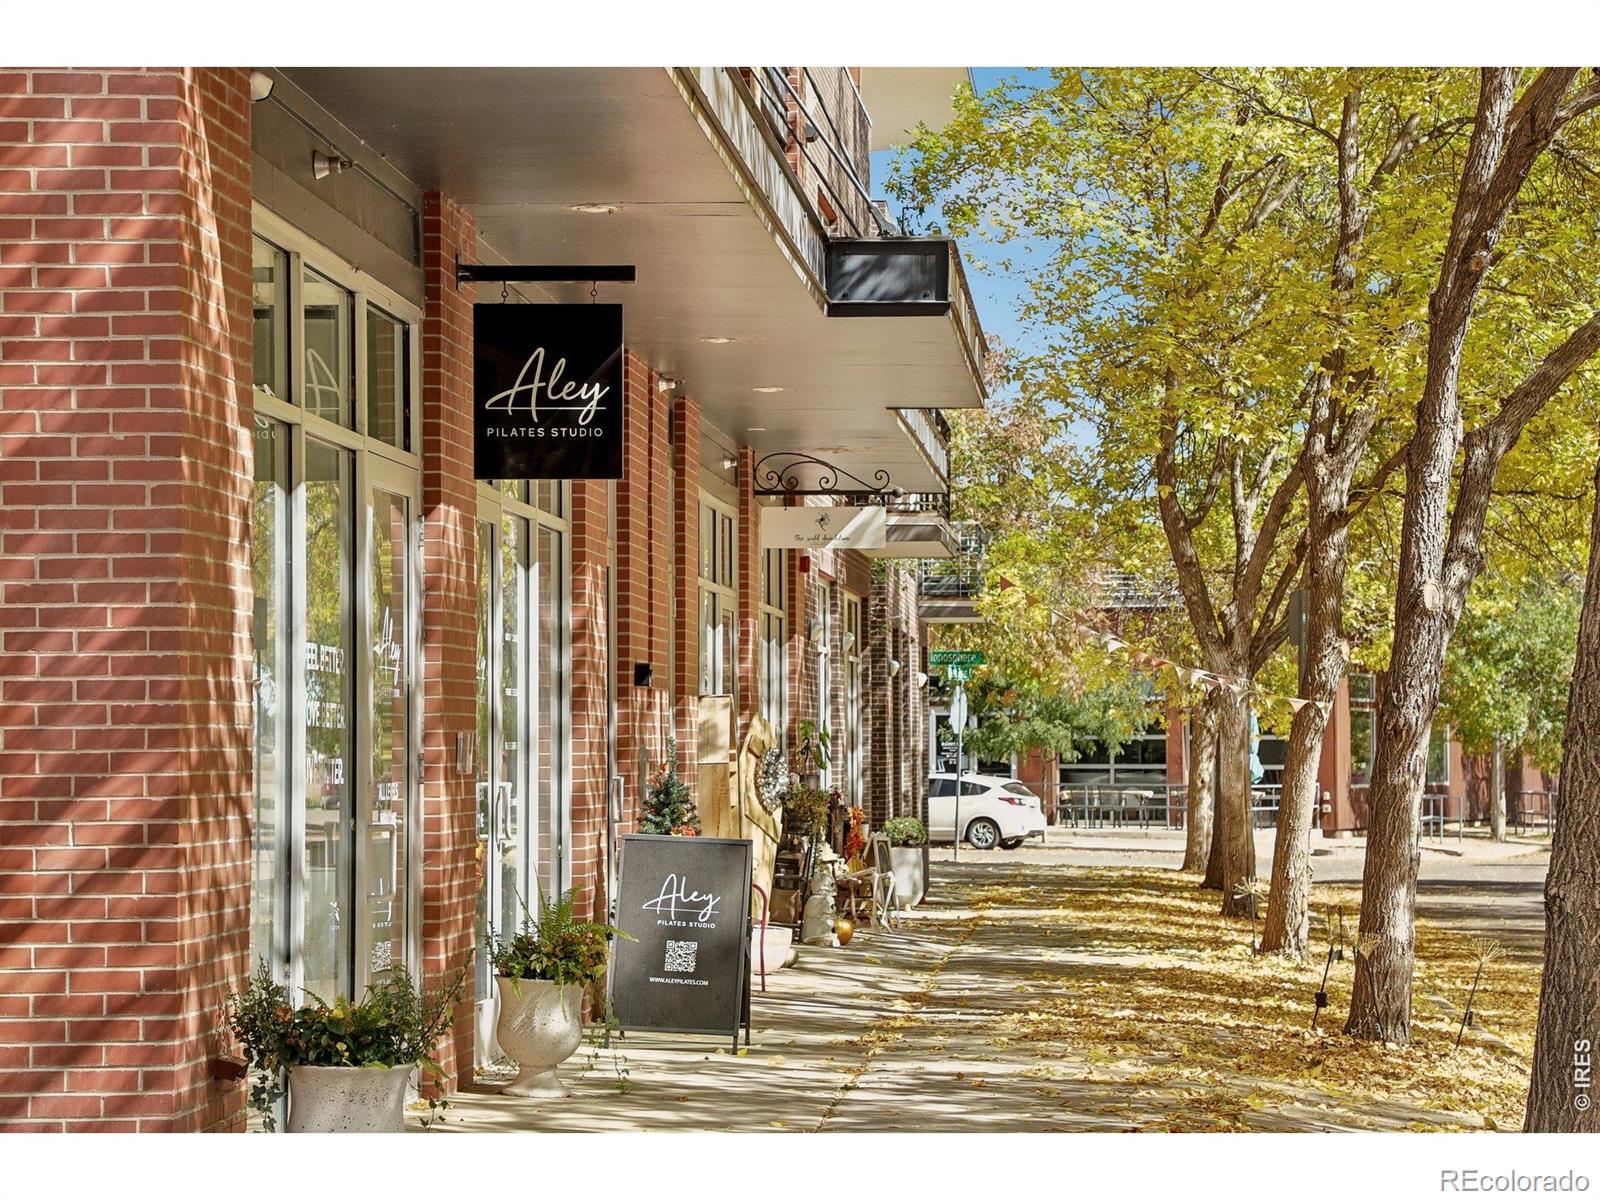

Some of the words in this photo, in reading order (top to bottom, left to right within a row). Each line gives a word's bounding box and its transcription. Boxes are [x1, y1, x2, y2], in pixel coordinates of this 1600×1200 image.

[485, 347, 610, 426] Aley
[487, 427, 545, 437] PILATES
[551, 427, 603, 437] STUDIO
[642, 873, 720, 921] Aley
[657, 918, 687, 928] PILATES
[688, 920, 716, 929] STUDIO
[649, 976, 709, 986] WWW.ALEYPILATES.COM
